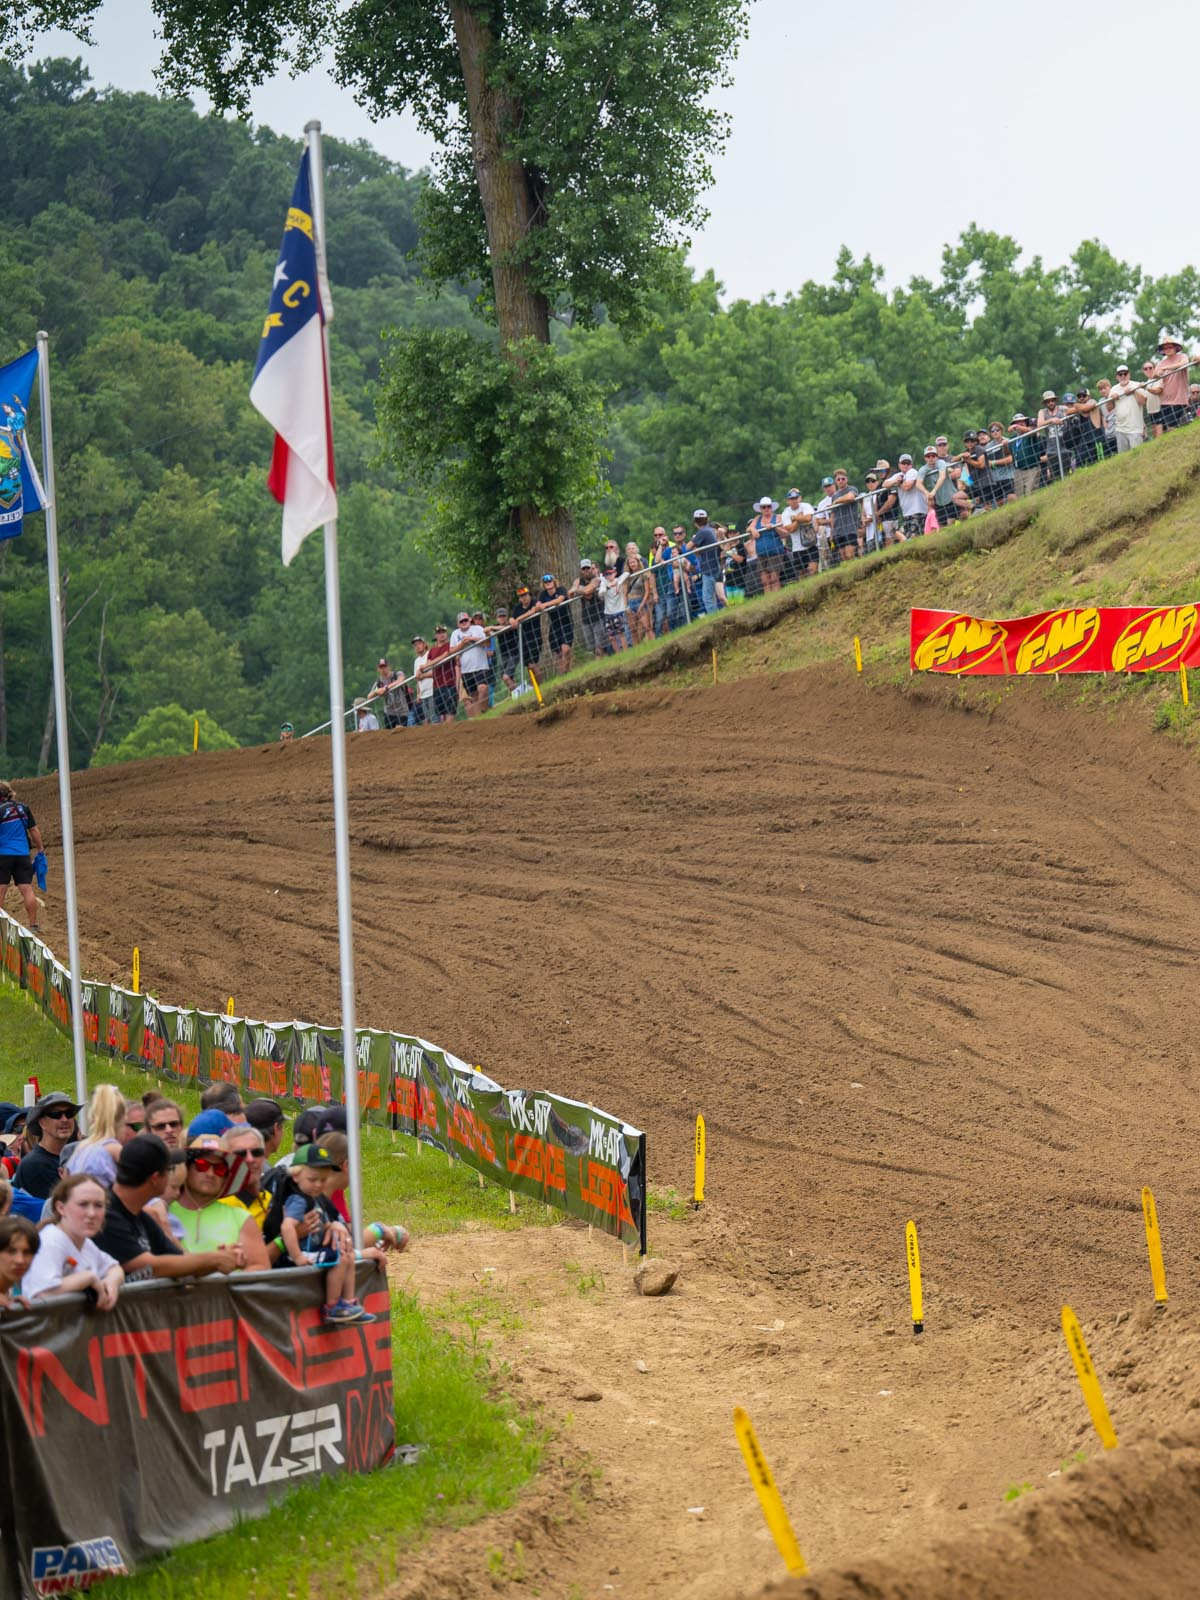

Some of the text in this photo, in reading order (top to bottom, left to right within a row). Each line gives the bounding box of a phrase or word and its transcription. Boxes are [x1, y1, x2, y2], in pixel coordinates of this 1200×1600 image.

[918, 618, 1000, 670] FMF
[1018, 608, 1097, 674] FMF
[1115, 605, 1195, 672] FMF
[908, 1234, 916, 1268] ACERBIS
[204, 1403, 345, 1496] TAZER
